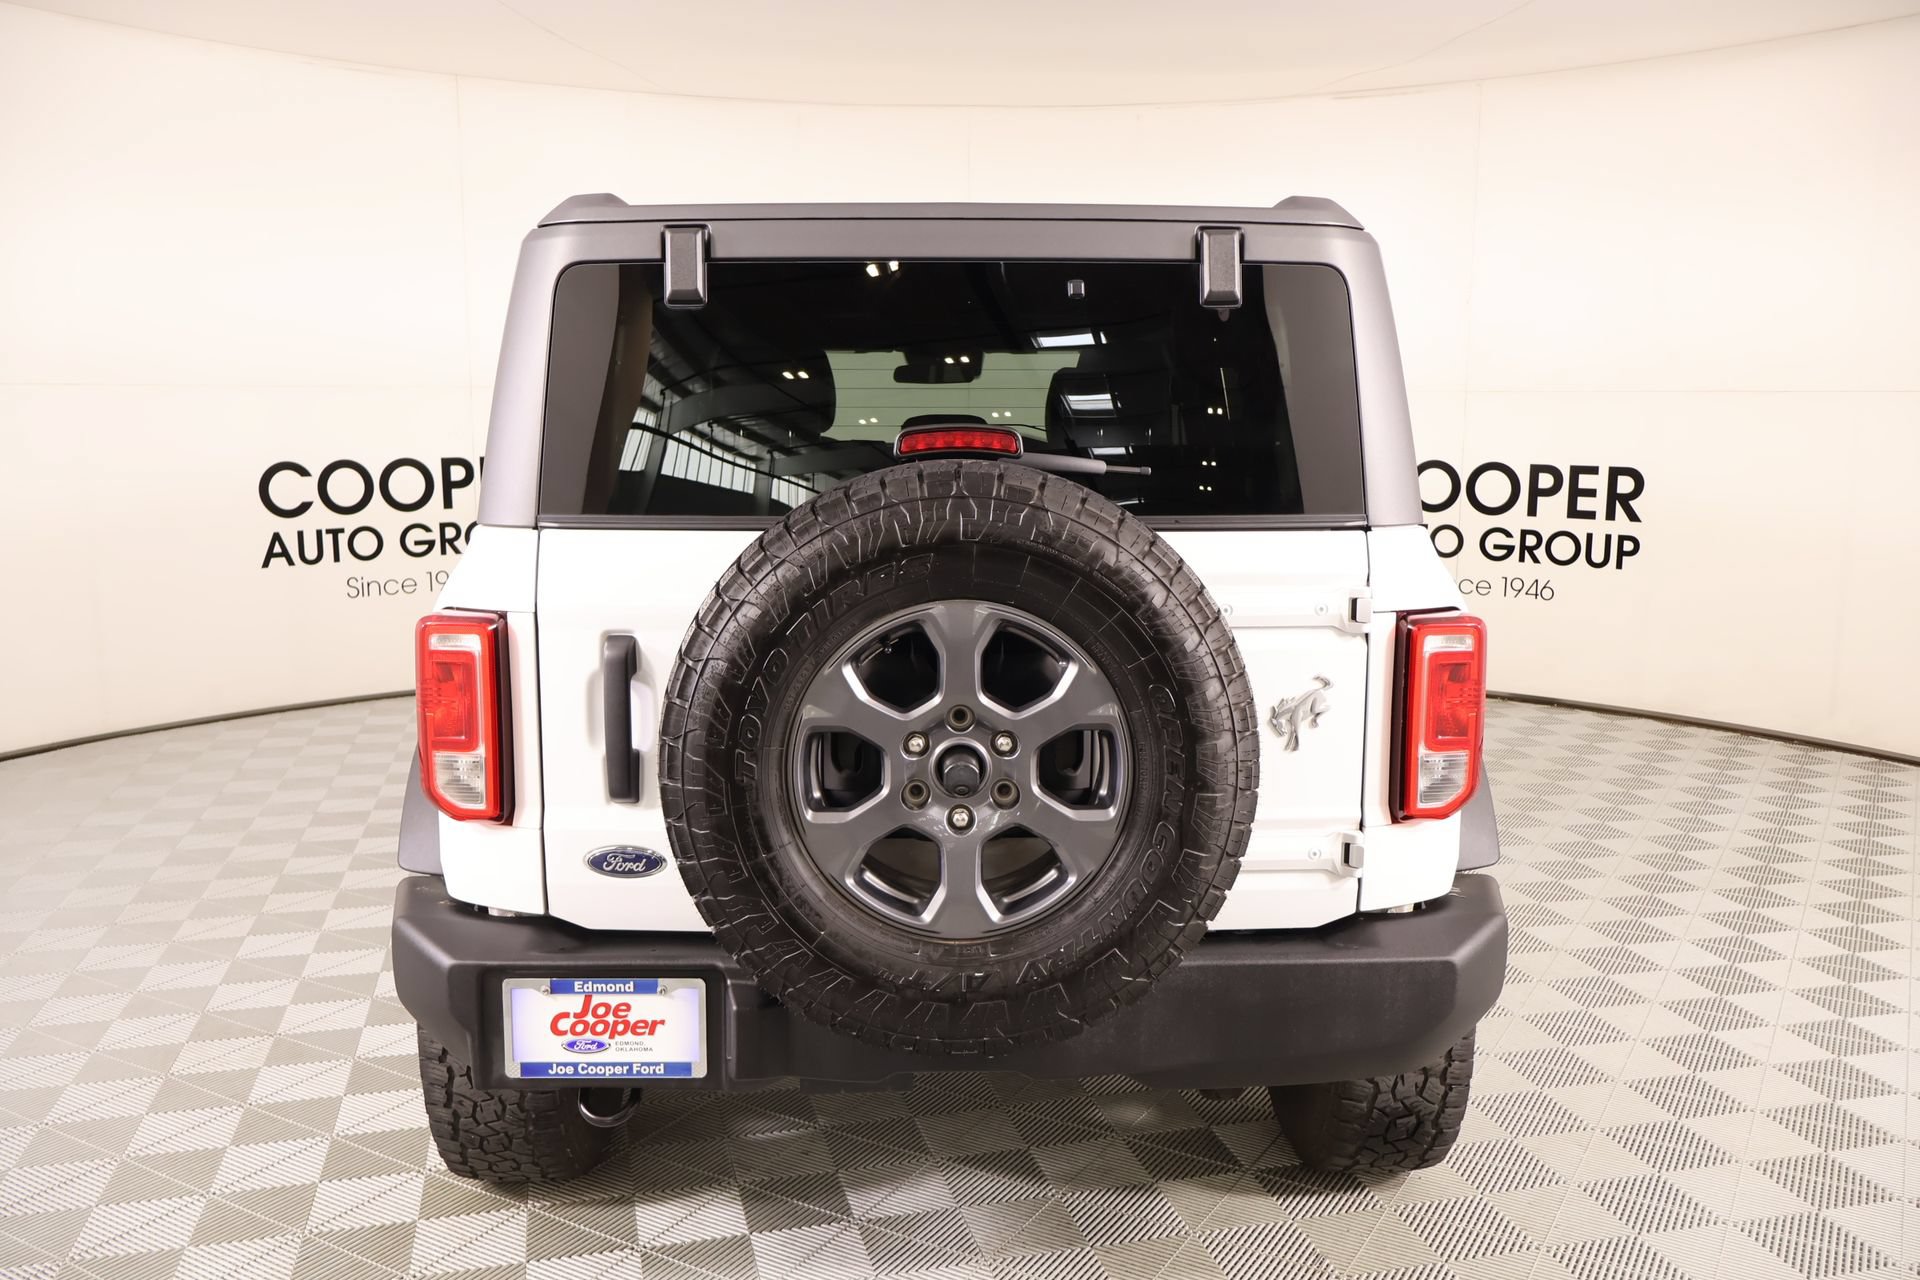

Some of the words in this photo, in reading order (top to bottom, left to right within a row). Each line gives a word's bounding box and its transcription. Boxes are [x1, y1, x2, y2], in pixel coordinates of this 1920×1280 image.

[261, 525, 384, 569] AUTO
[1479, 527, 1640, 570] GROUP
[346, 576, 417, 599] Since
[1501, 576, 1554, 601] 1946
[734, 647, 789, 781] TOYO
[603, 853, 646, 872] Ford
[574, 980, 634, 993] Edmond
[573, 994, 632, 1019] Joe
[550, 1011, 666, 1039] Cooper
[573, 1040, 598, 1051] Ford
[548, 1063, 574, 1074] Joe
[578, 1063, 628, 1077] Cooper
[633, 1063, 665, 1074] Ford
